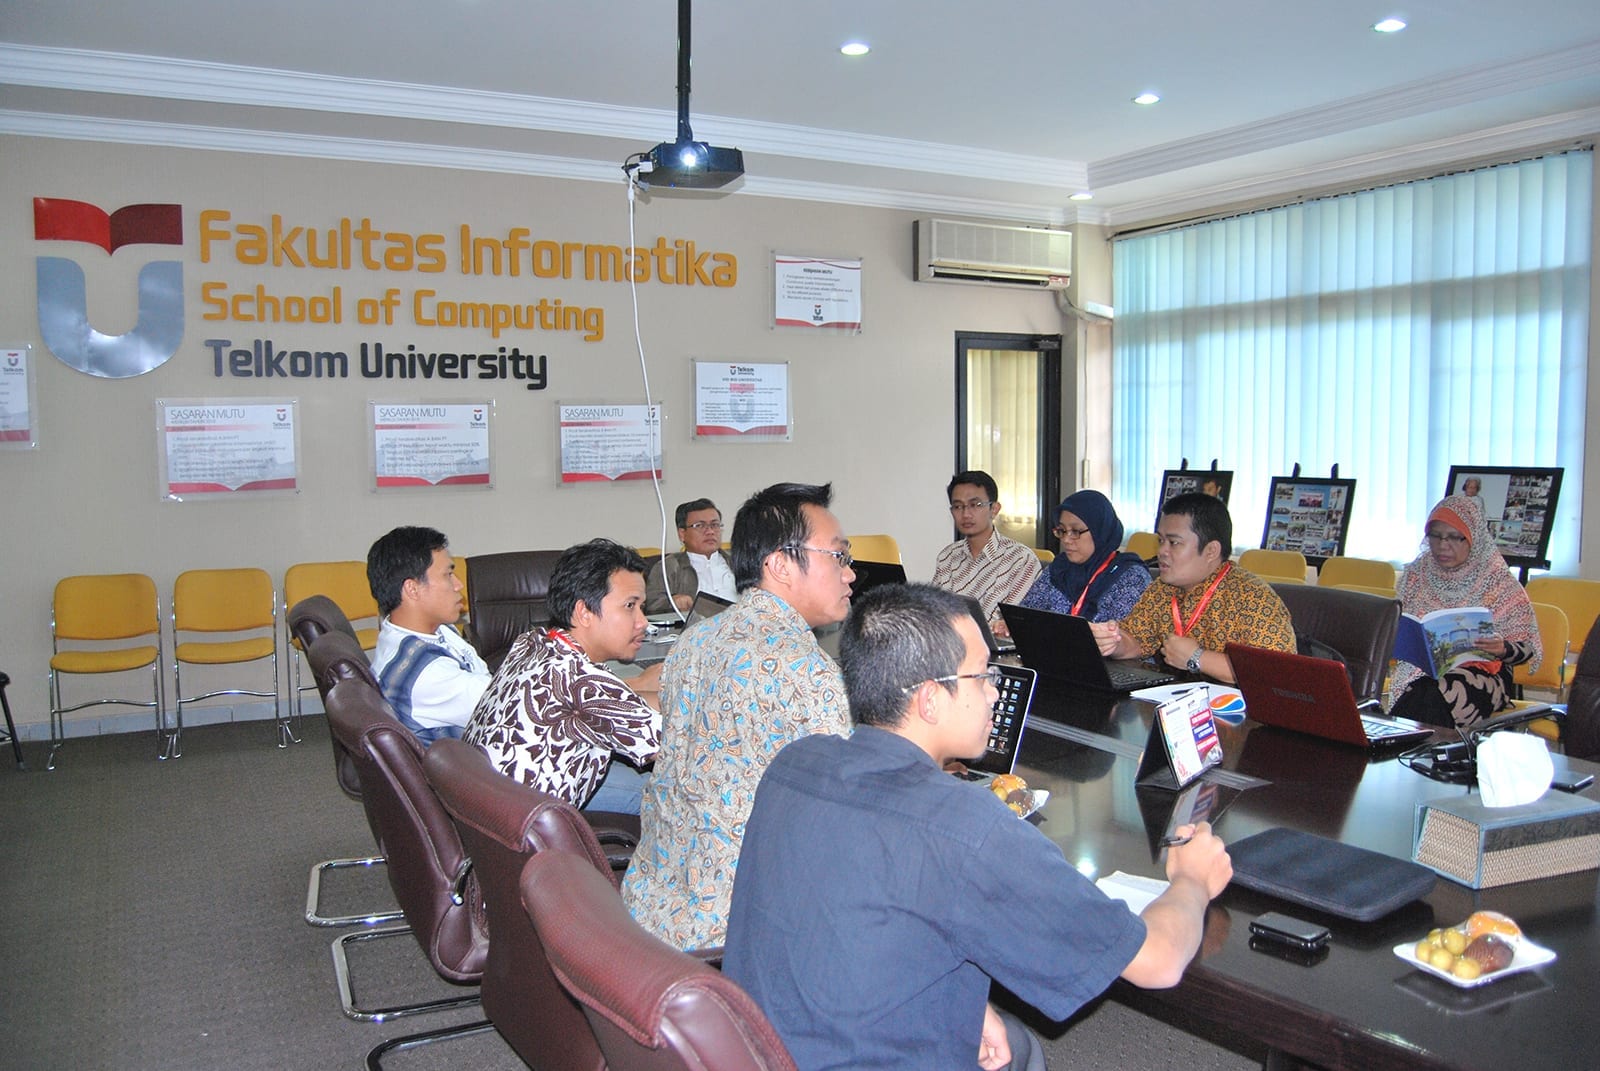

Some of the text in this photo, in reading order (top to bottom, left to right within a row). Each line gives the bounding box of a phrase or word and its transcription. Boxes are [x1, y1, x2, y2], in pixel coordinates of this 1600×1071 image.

[200, 209, 447, 274] Fakultas
[460, 223, 738, 288] Informatika
[201, 281, 605, 342] School of Computing
[204, 339, 548, 391] Telkom University
[170, 408, 246, 420] SASARAN MUTU
[379, 407, 447, 418] SASARAN MUTU
[564, 407, 624, 417] SASARAN MUTU
